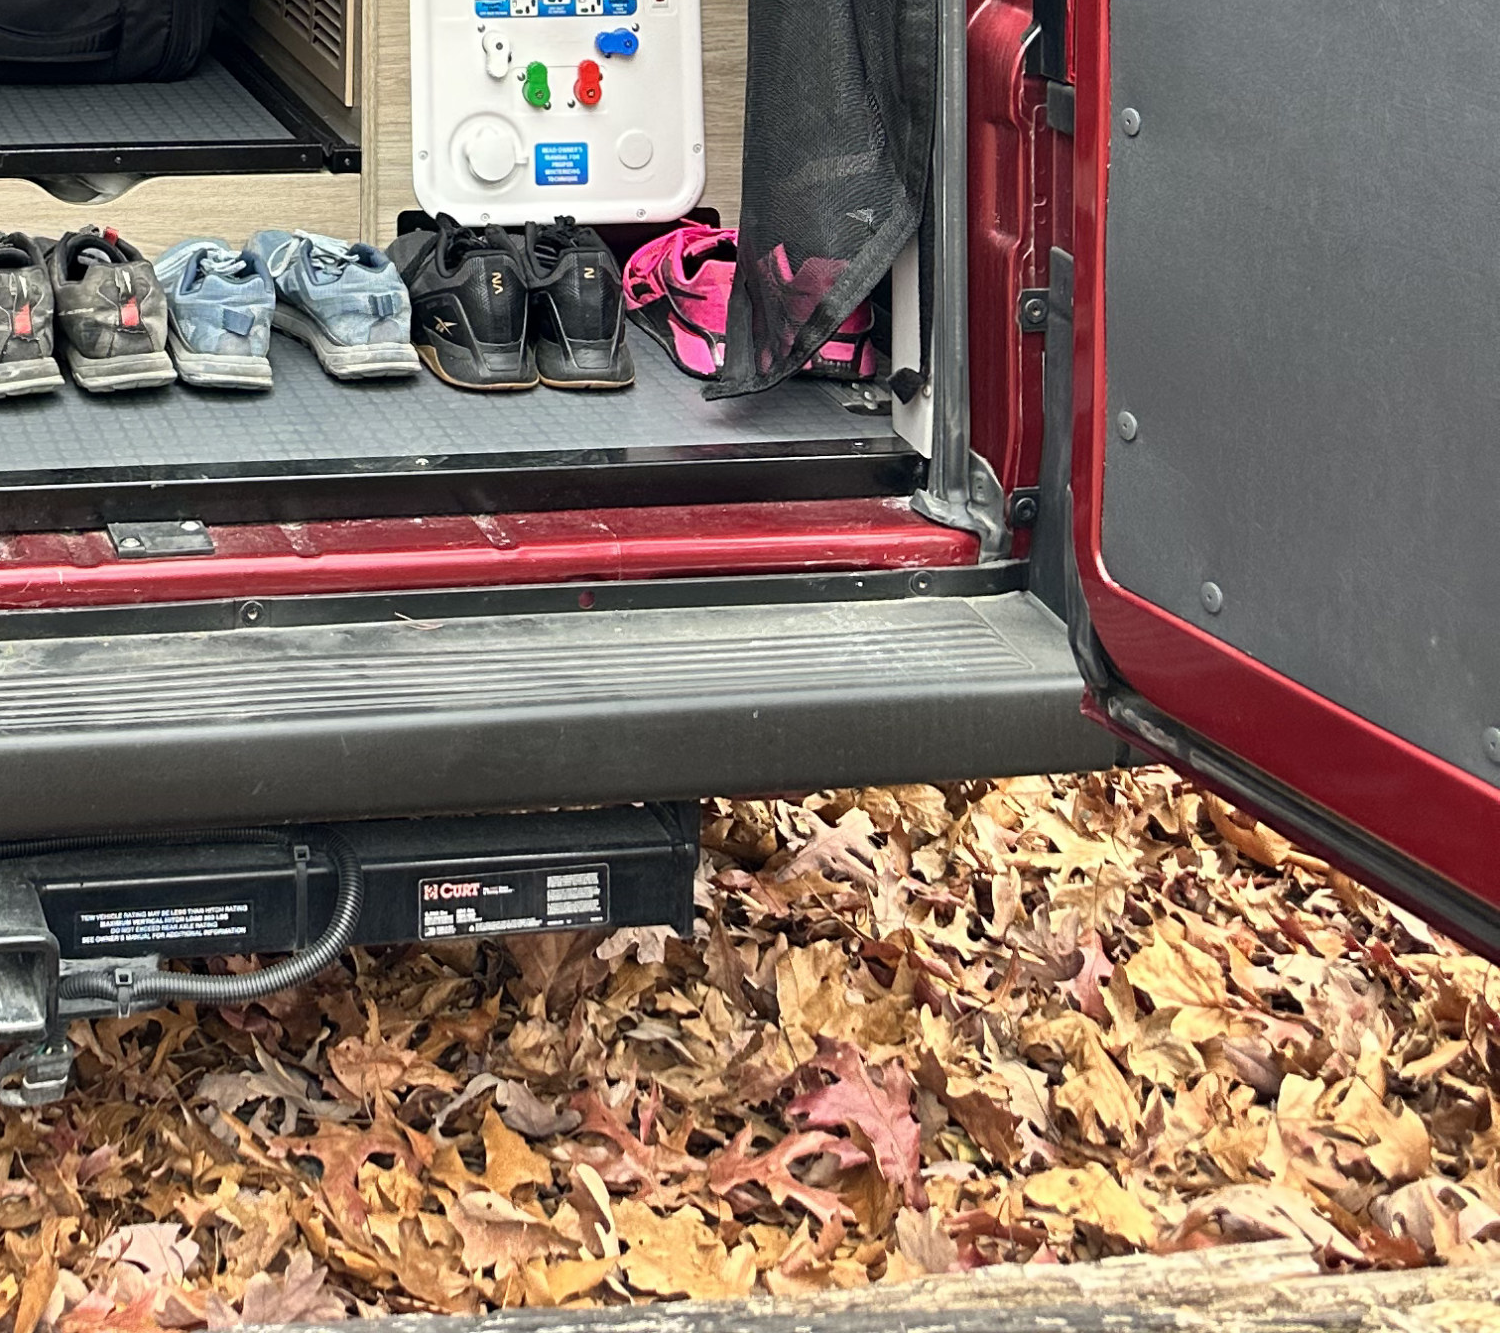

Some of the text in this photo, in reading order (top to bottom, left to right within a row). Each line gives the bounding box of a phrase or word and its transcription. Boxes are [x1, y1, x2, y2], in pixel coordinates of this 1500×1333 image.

[440, 882, 481, 899] CURT
[96, 912, 122, 921] VEHICLE
[124, 911, 146, 919] RATING
[225, 904, 248, 912] RATING
[100, 919, 131, 928] MAXIMUM
[133, 917, 163, 925] VERTICAL
[82, 936, 94, 944] SEE
[126, 933, 151, 941] MANUAL
[166, 930, 202, 938] ADDITIONAL
[203, 927, 247, 936] INFORMATION
